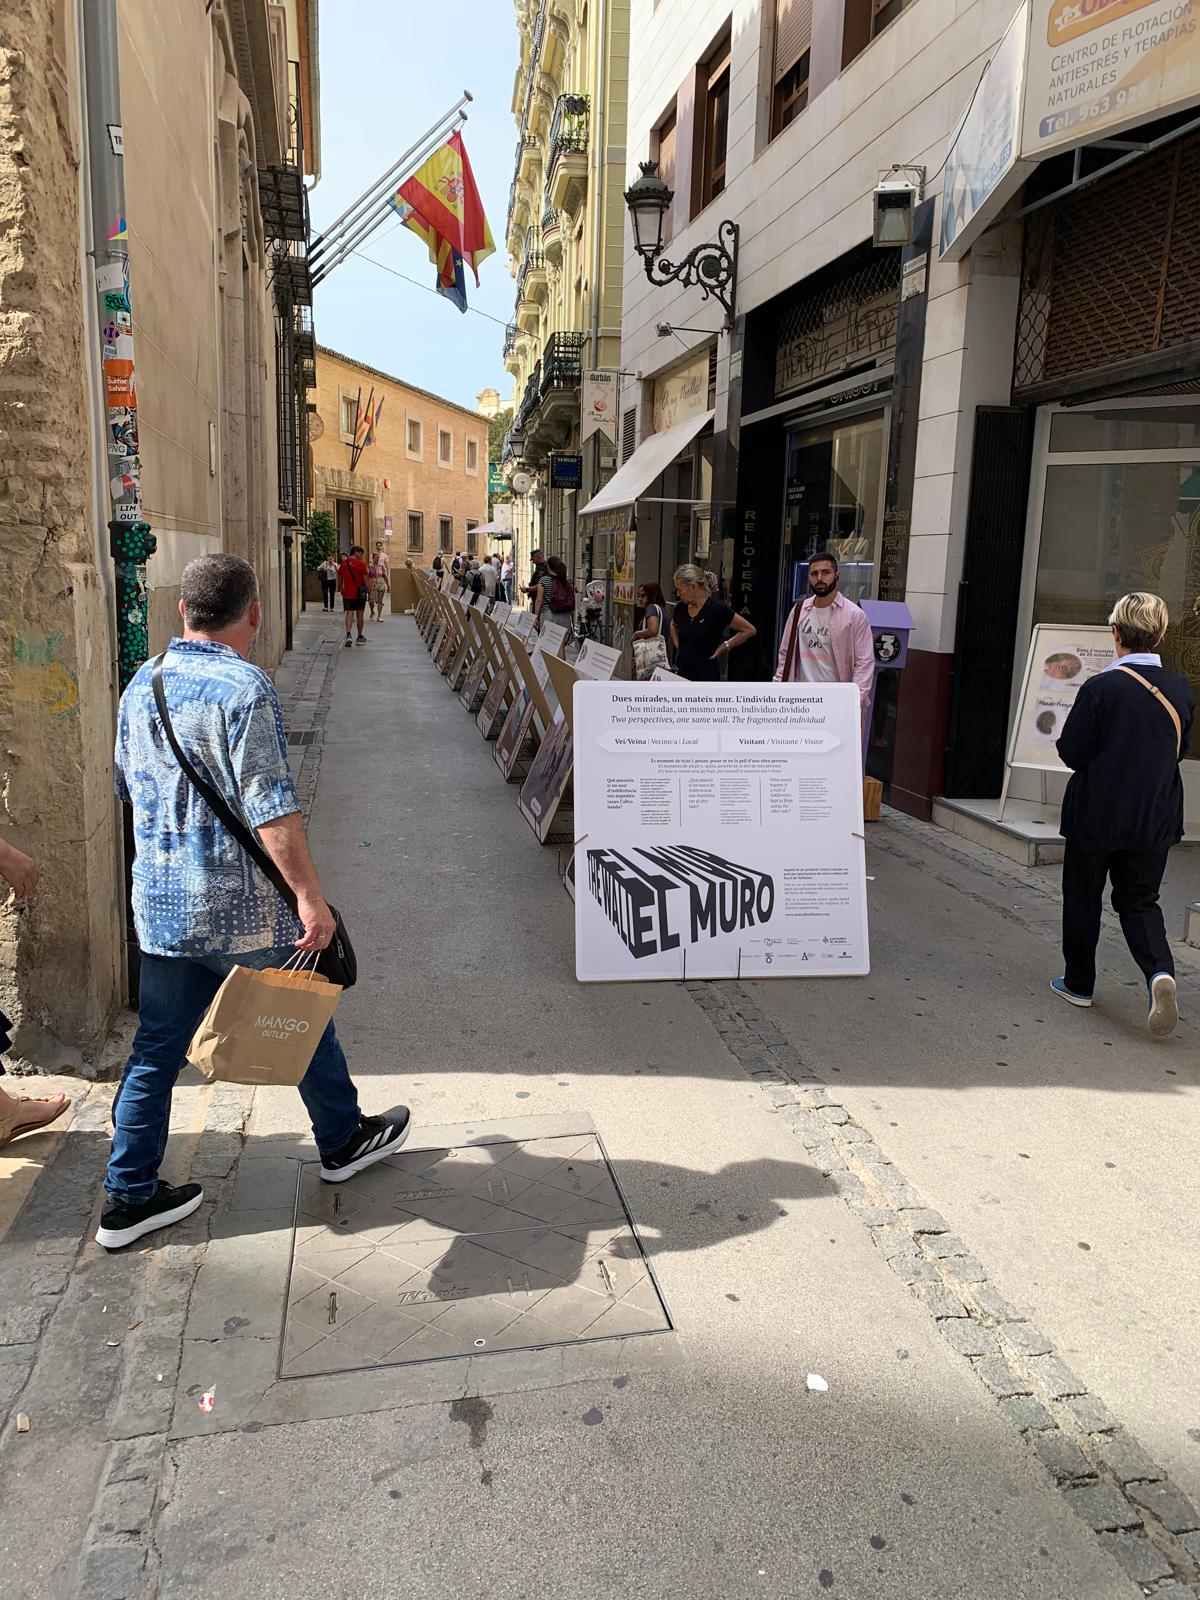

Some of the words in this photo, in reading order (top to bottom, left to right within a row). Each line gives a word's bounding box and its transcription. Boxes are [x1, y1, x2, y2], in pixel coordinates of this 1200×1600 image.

[1102, 33, 1119, 51] DE
[1121, 2, 1193, 42] FLOTACIÓN
[1048, 50, 1120, 90] ANTIESTRÉS
[1123, 46, 1132, 59] Y
[1135, 19, 1197, 53] TERAPIAS
[1047, 69, 1118, 107] NATURALES
[1045, 112, 1073, 135] Tel.
[1079, 97, 1111, 122] 963
[879, 634, 895, 658] 3
[626, 705, 641, 713] Dos
[643, 705, 676, 714] miradas,
[690, 705, 715, 713] mismo
[741, 705, 778, 713] Individuo
[779, 705, 810, 713] dividido
[634, 695, 670, 703] mirades,
[778, 695, 824, 705] fragmentat
[611, 715, 627, 723] Two
[628, 716, 675, 724] perspectives,
[747, 716, 788, 725] fragmented
[789, 716, 826, 724] individual
[631, 884, 681, 959] EL
[689, 874, 775, 944] MURO
[255, 1015, 310, 1034] MANGO
[262, 1029, 290, 1040] OUTLET
